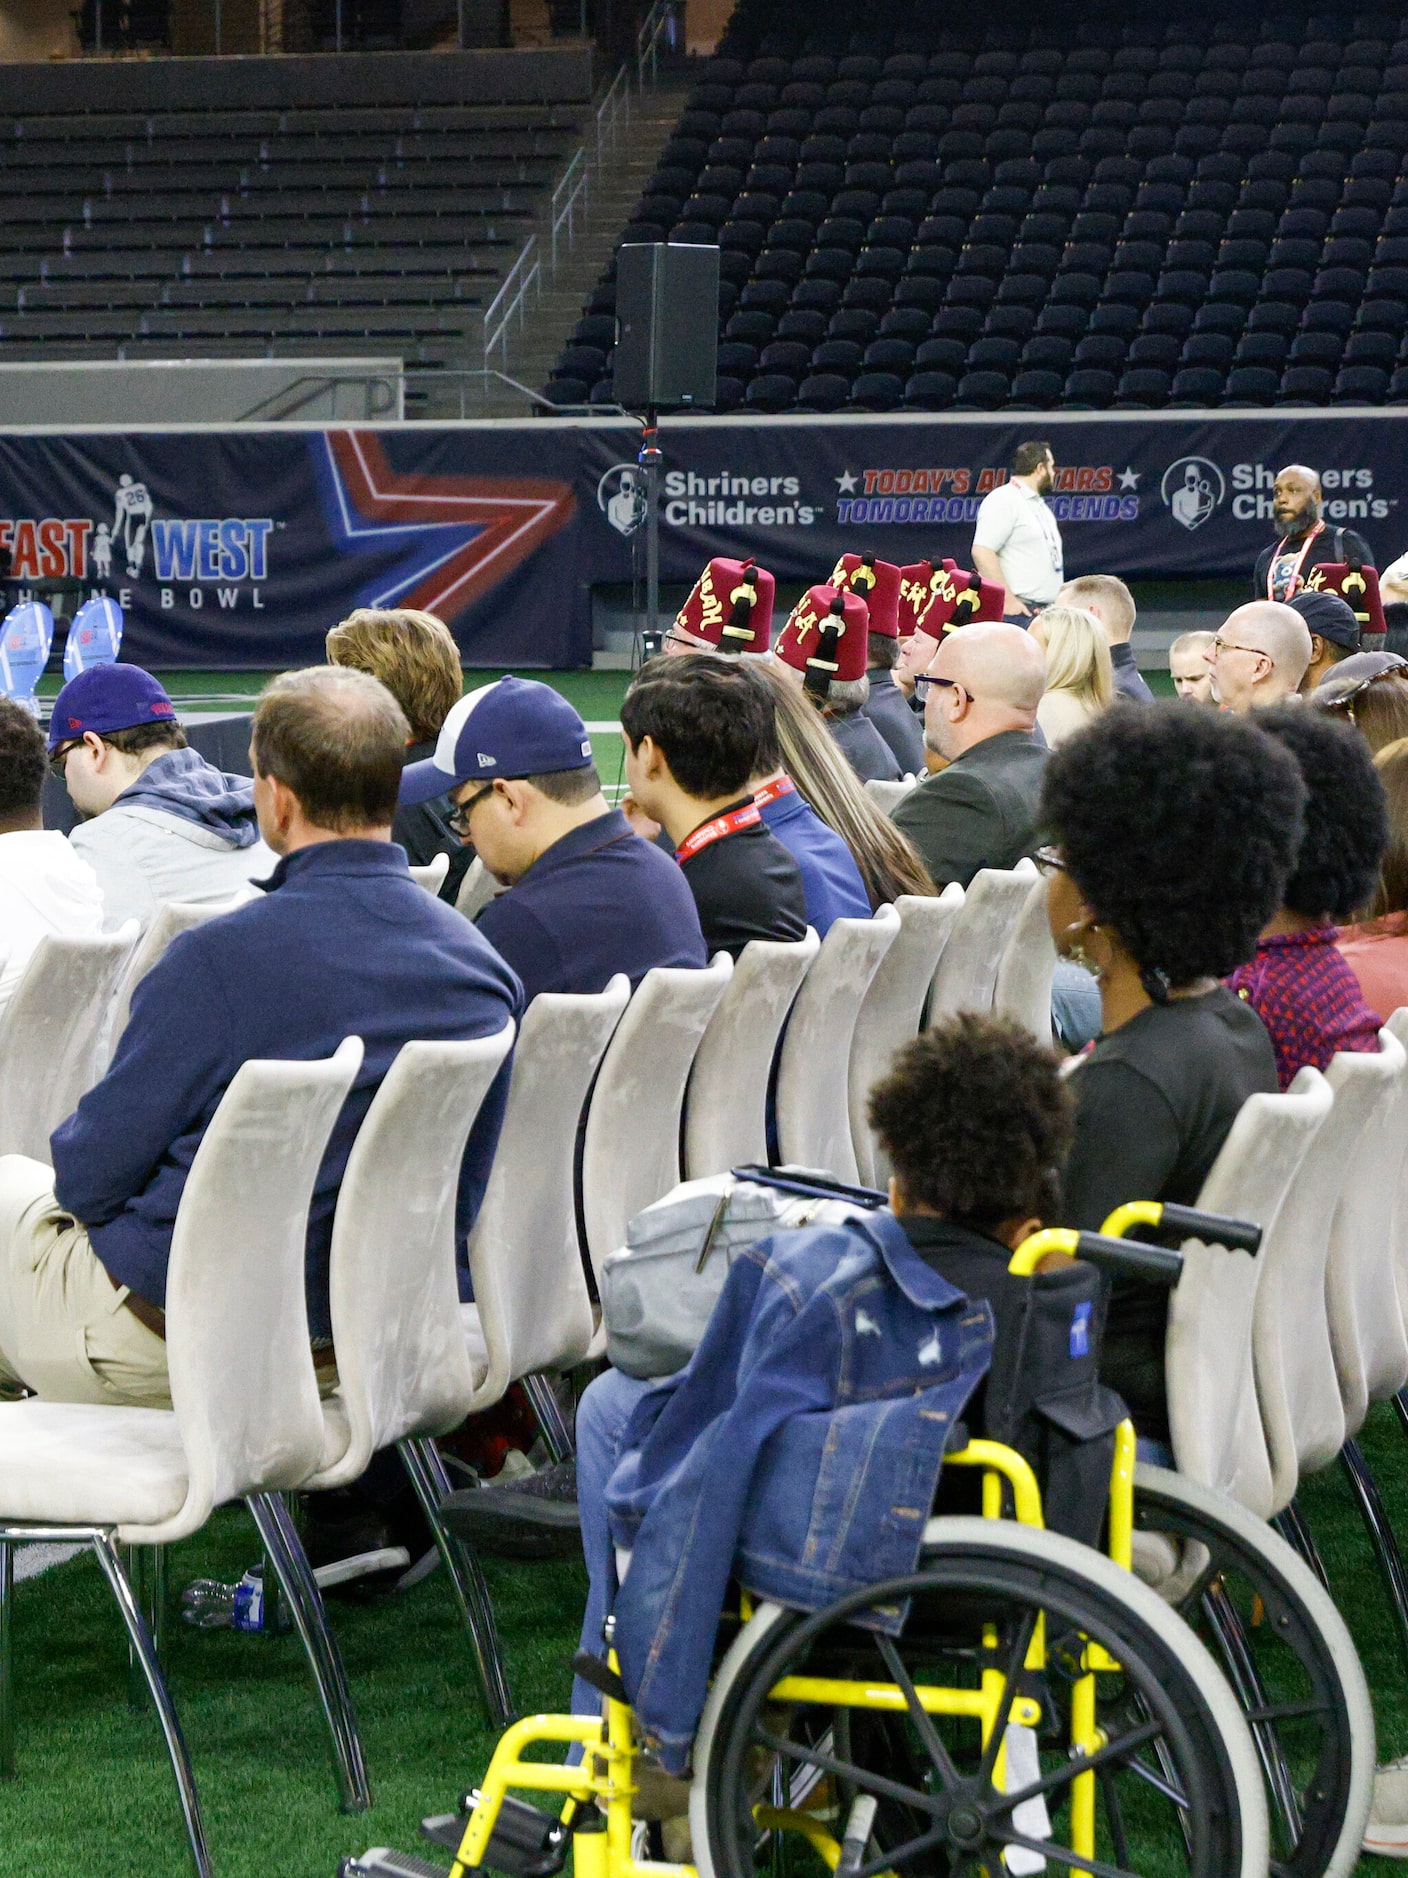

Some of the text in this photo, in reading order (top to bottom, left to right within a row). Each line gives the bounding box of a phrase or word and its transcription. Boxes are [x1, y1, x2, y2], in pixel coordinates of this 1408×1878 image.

[665, 471, 800, 496] Shriners
[863, 469, 970, 494] TODAY'S
[665, 501, 814, 526] Children's
[151, 519, 274, 581] WEST
[161, 588, 265, 609] BOWL
